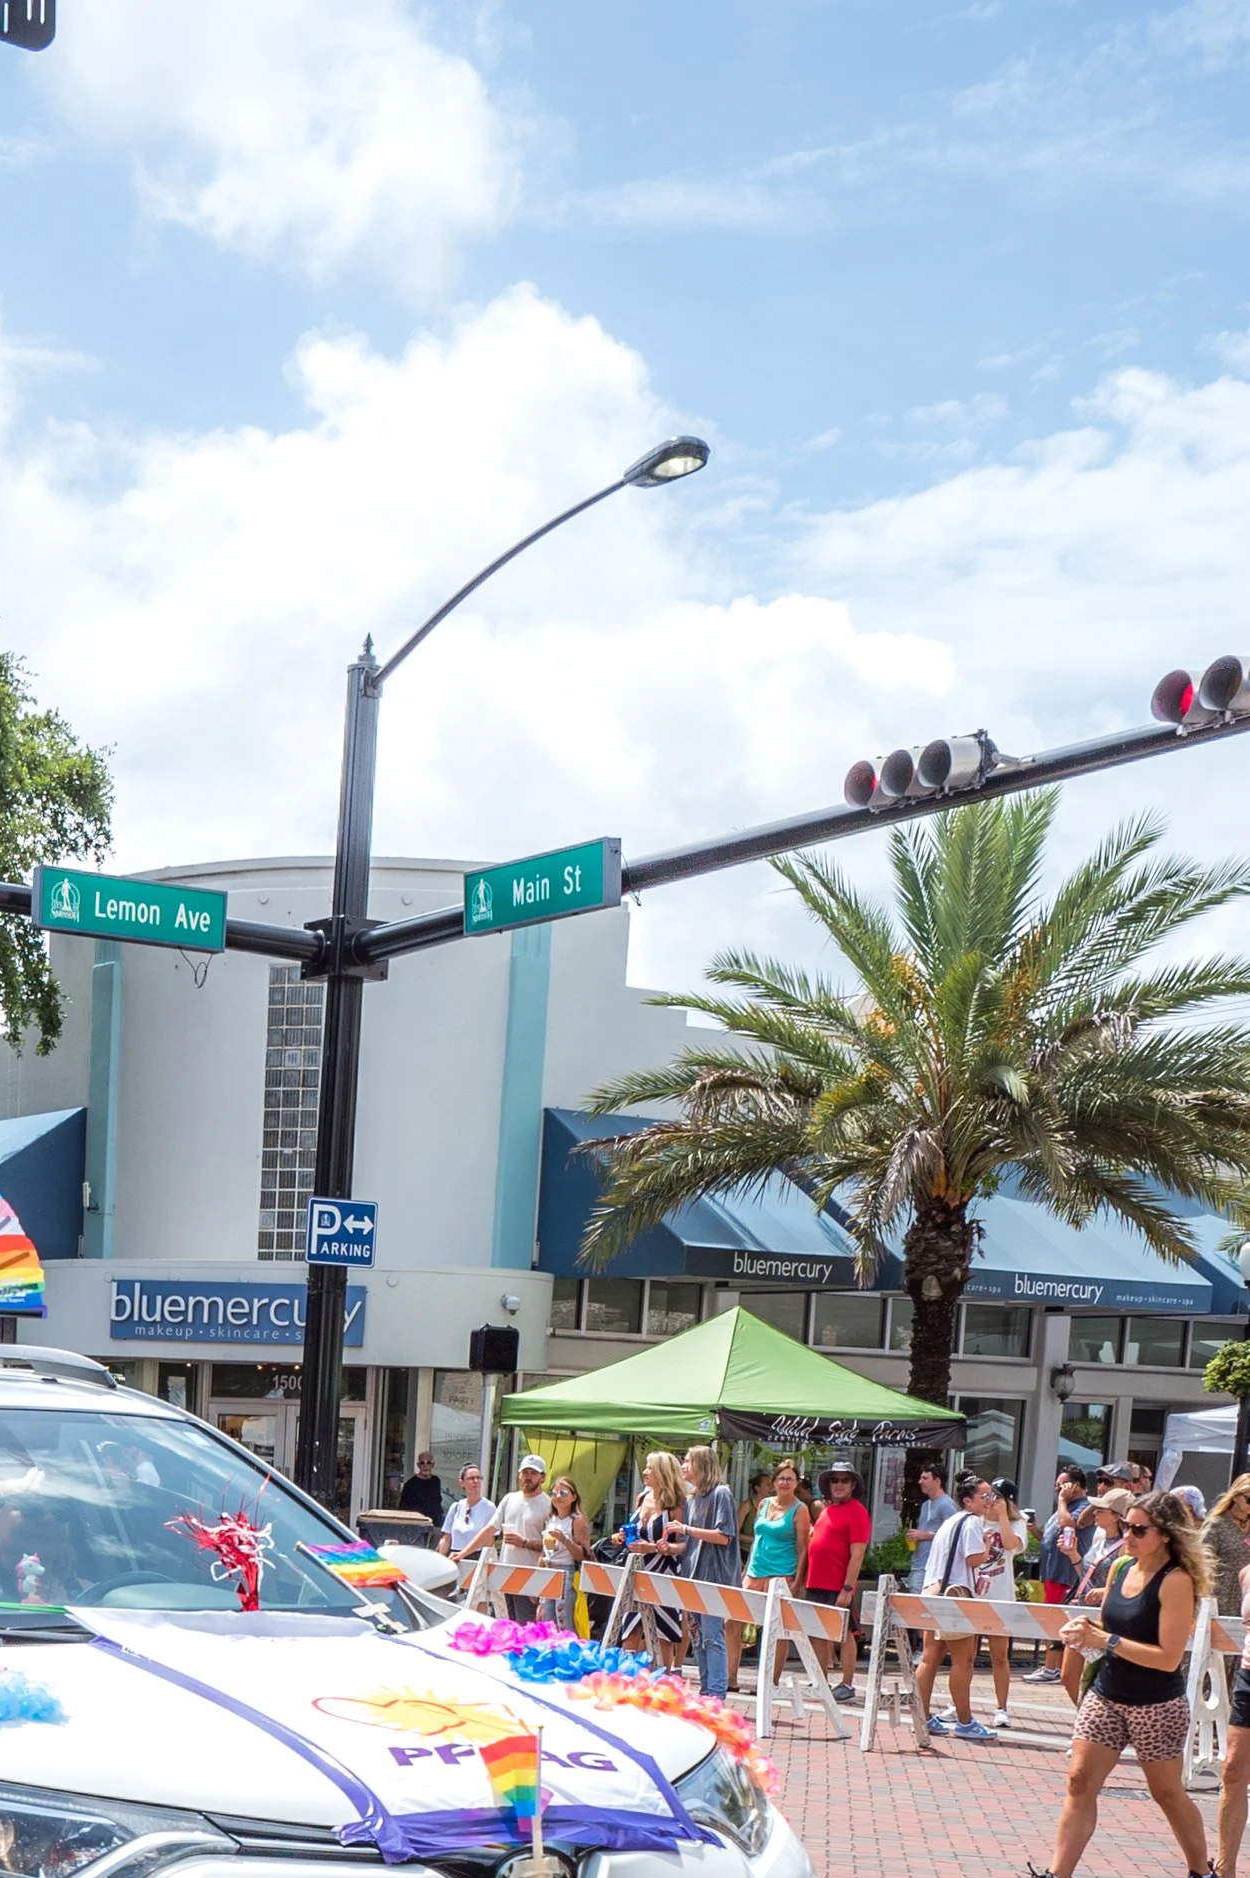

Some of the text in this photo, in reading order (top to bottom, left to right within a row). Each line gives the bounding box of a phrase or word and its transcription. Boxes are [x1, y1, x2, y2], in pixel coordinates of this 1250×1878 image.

[513, 865, 582, 907] Main St
[94, 891, 161, 925] Lemon
[174, 903, 211, 932] Ave
[733, 1251, 833, 1284] bluemercury
[966, 1284, 983, 1292] care
[1014, 1274, 1104, 1304] bluemercury
[1116, 1294, 1143, 1304] makeup
[1148, 1295, 1177, 1305] skincare
[110, 1281, 363, 1333] bluemercuy
[134, 1325, 194, 1338] makeup
[209, 1327, 280, 1340] skincare
[771, 1415, 819, 1438] Wild
[871, 1421, 919, 1442] Farms
[387, 1743, 619, 1772] PFAG
